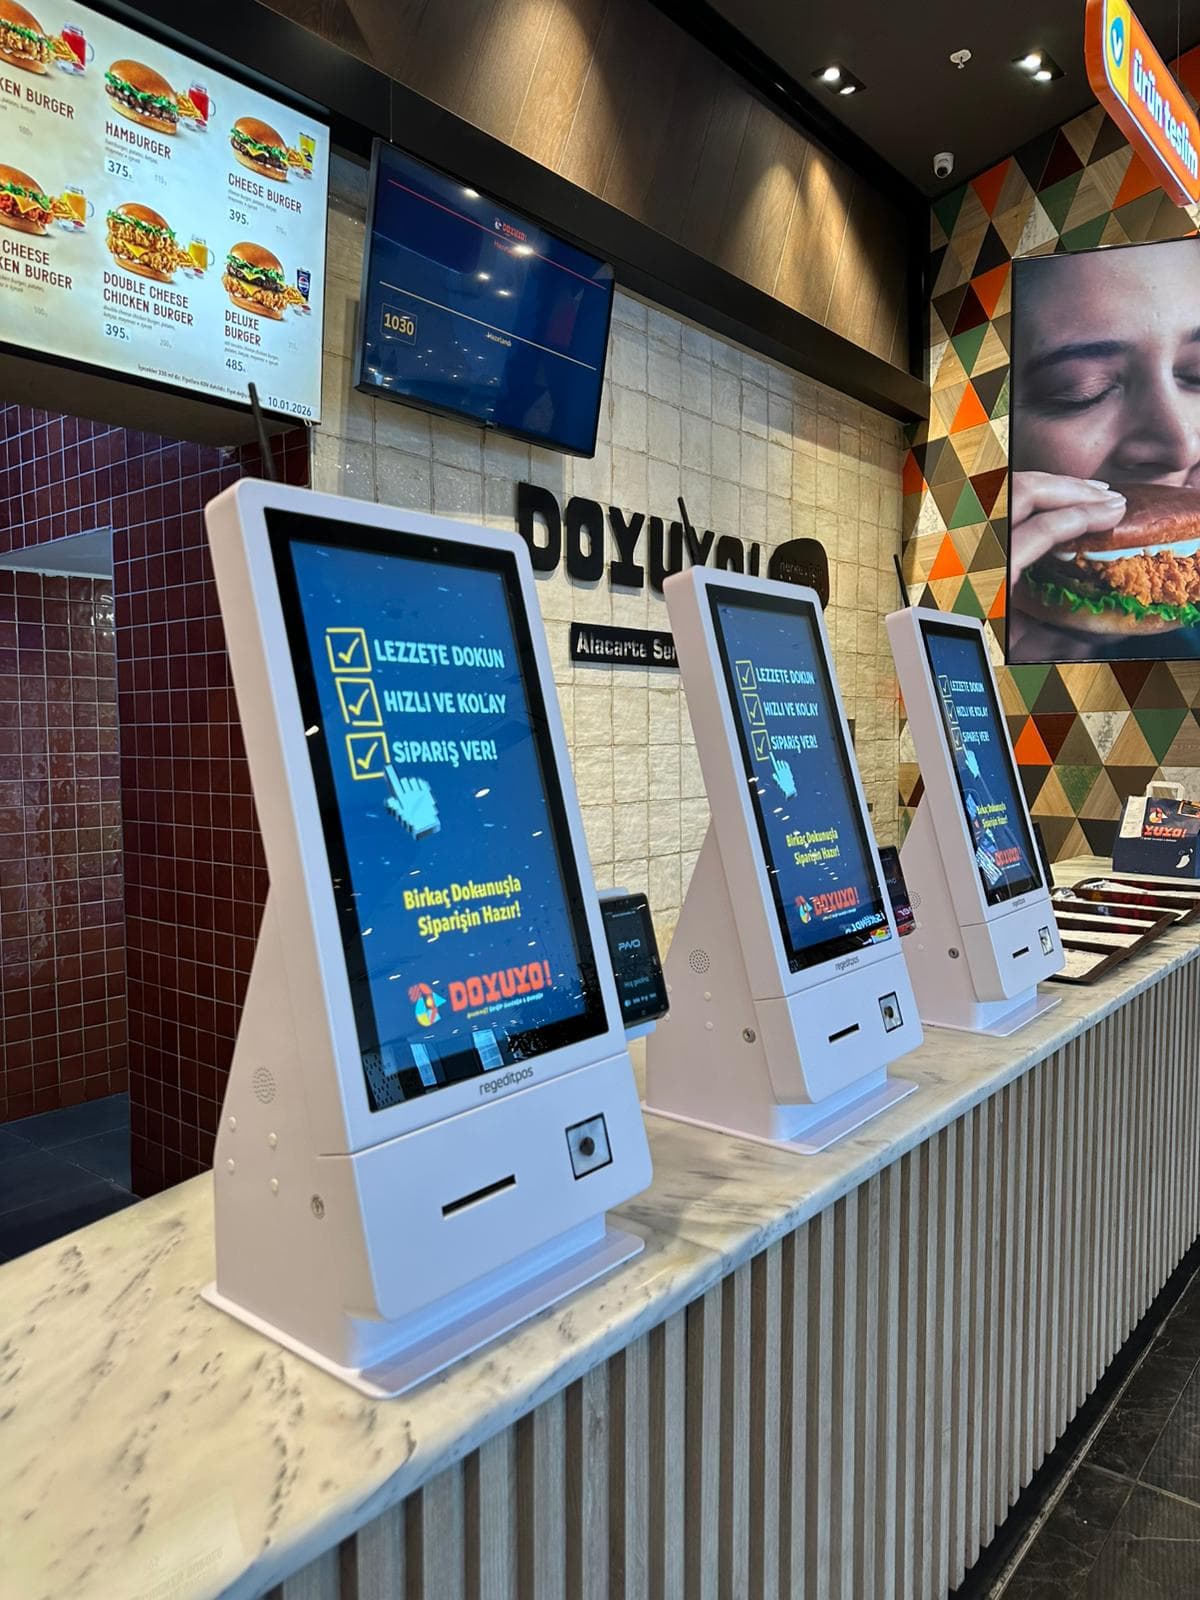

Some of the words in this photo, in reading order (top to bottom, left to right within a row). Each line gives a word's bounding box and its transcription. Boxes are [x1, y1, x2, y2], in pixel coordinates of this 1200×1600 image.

[26, 88, 74, 120] BURGER
[1132, 48, 1163, 128] ürün
[1163, 100, 1198, 180] teslim
[106, 121, 171, 160] HAMBURGER
[228, 173, 264, 195] CHEESE
[267, 189, 302, 214] BURGER
[2, 239, 50, 266] CHEESE
[25, 264, 73, 290] BURGER
[103, 271, 146, 297] DOUBLE
[149, 282, 189, 309] CHEESE
[103, 289, 150, 314] CHICKEN
[153, 303, 194, 327] BURGER
[225, 310, 259, 331] DELUXE
[225, 325, 261, 347] BURGER
[383, 312, 415, 337] 1030
[267, 396, 312, 418] 10.01.2026
[374, 639, 450, 666] LEZZETE
[452, 645, 505, 669] DOKUN
[576, 631, 648, 658] Alacarte
[755, 667, 790, 684] LEZZETE
[790, 671, 816, 685] DOKUN
[383, 690, 431, 713] HIZLI
[432, 691, 456, 713] VE
[458, 692, 506, 714] KOLAY
[763, 702, 785, 717] HIZLI
[785, 703, 796, 717] VE
[796, 702, 819, 717] KOLAY
[460, 740, 498, 761] VER!
[801, 734, 818, 749] VER!
[403, 886, 450, 911] Birkaç
[451, 874, 522, 902] Dokunuşla
[812, 886, 860, 916] DOYUYO!
[418, 909, 482, 937] Siparişin
[482, 900, 521, 923] Hazır!
[448, 960, 553, 1013] DOYUYO!
[479, 1065, 534, 1095] regeditpos
